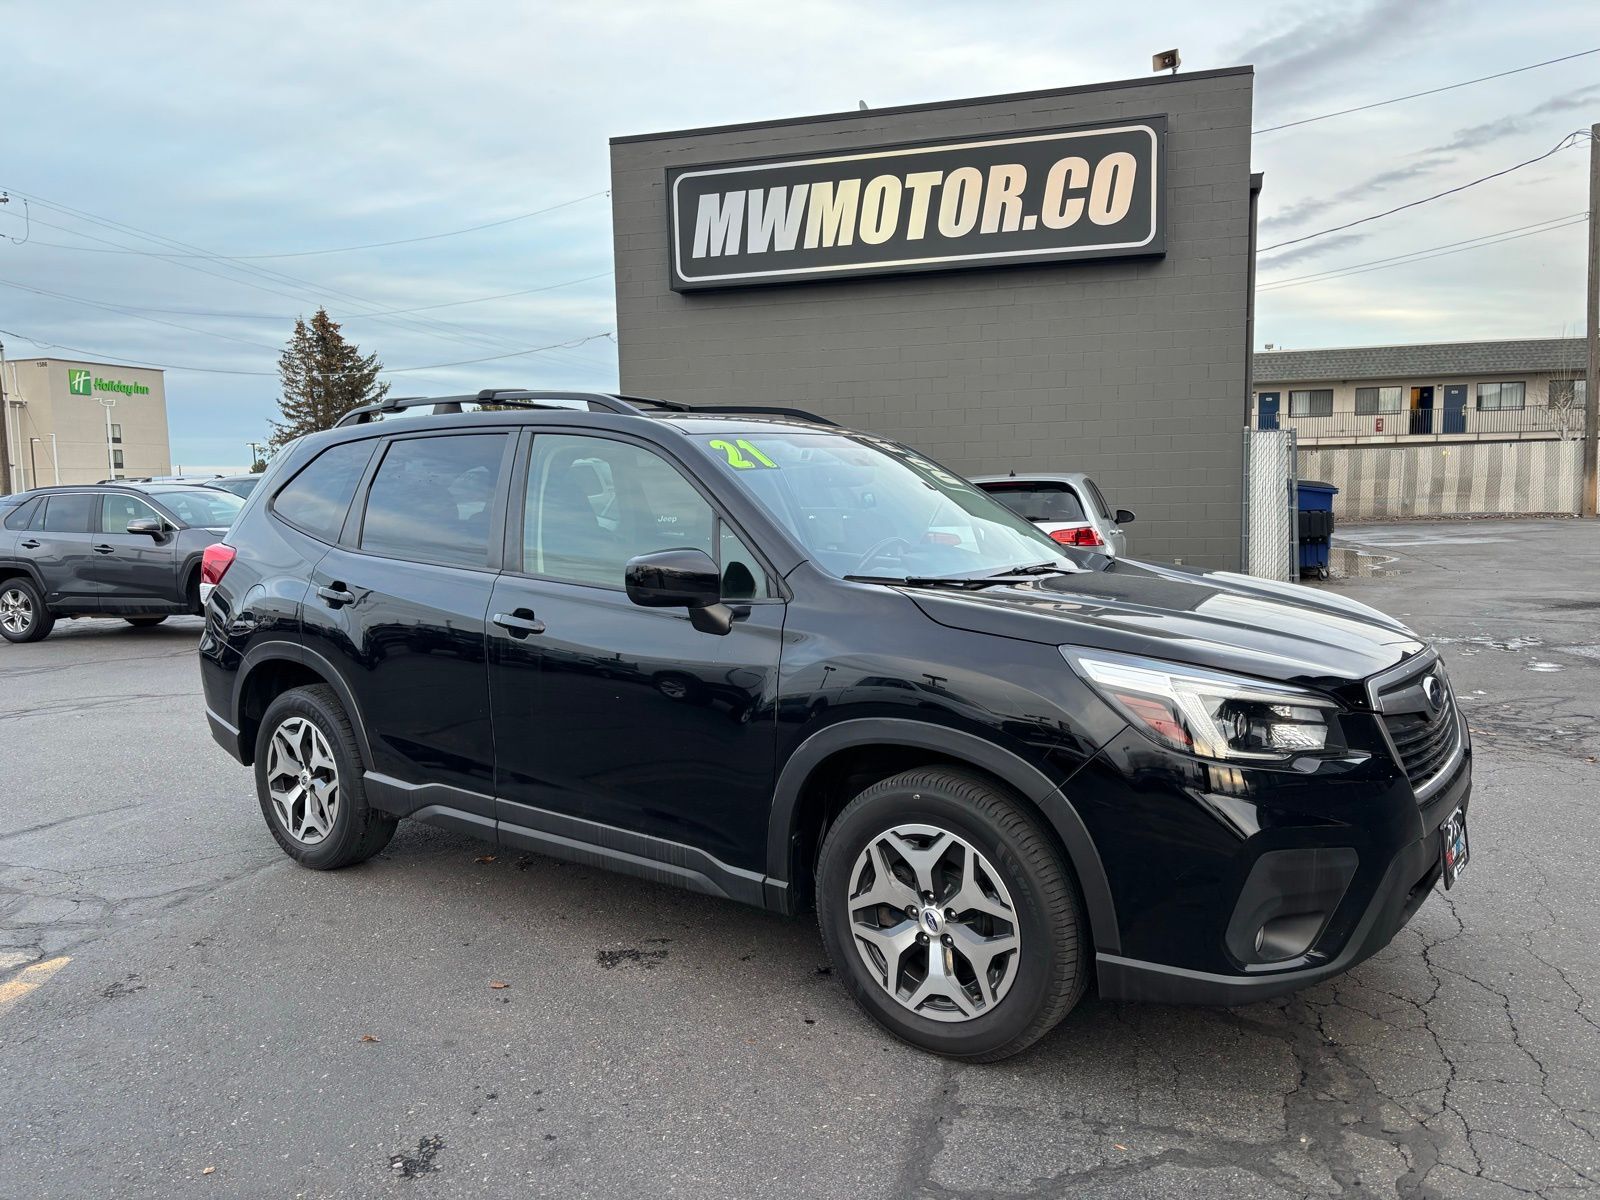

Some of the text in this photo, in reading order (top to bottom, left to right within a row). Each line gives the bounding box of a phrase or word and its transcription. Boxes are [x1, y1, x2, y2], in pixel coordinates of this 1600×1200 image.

[692, 151, 1137, 259] MWMOTOR.CO
[94, 377, 149, 396] Holiday Inn
[709, 439, 778, 469] 21
[657, 515, 678, 523] Jeep
